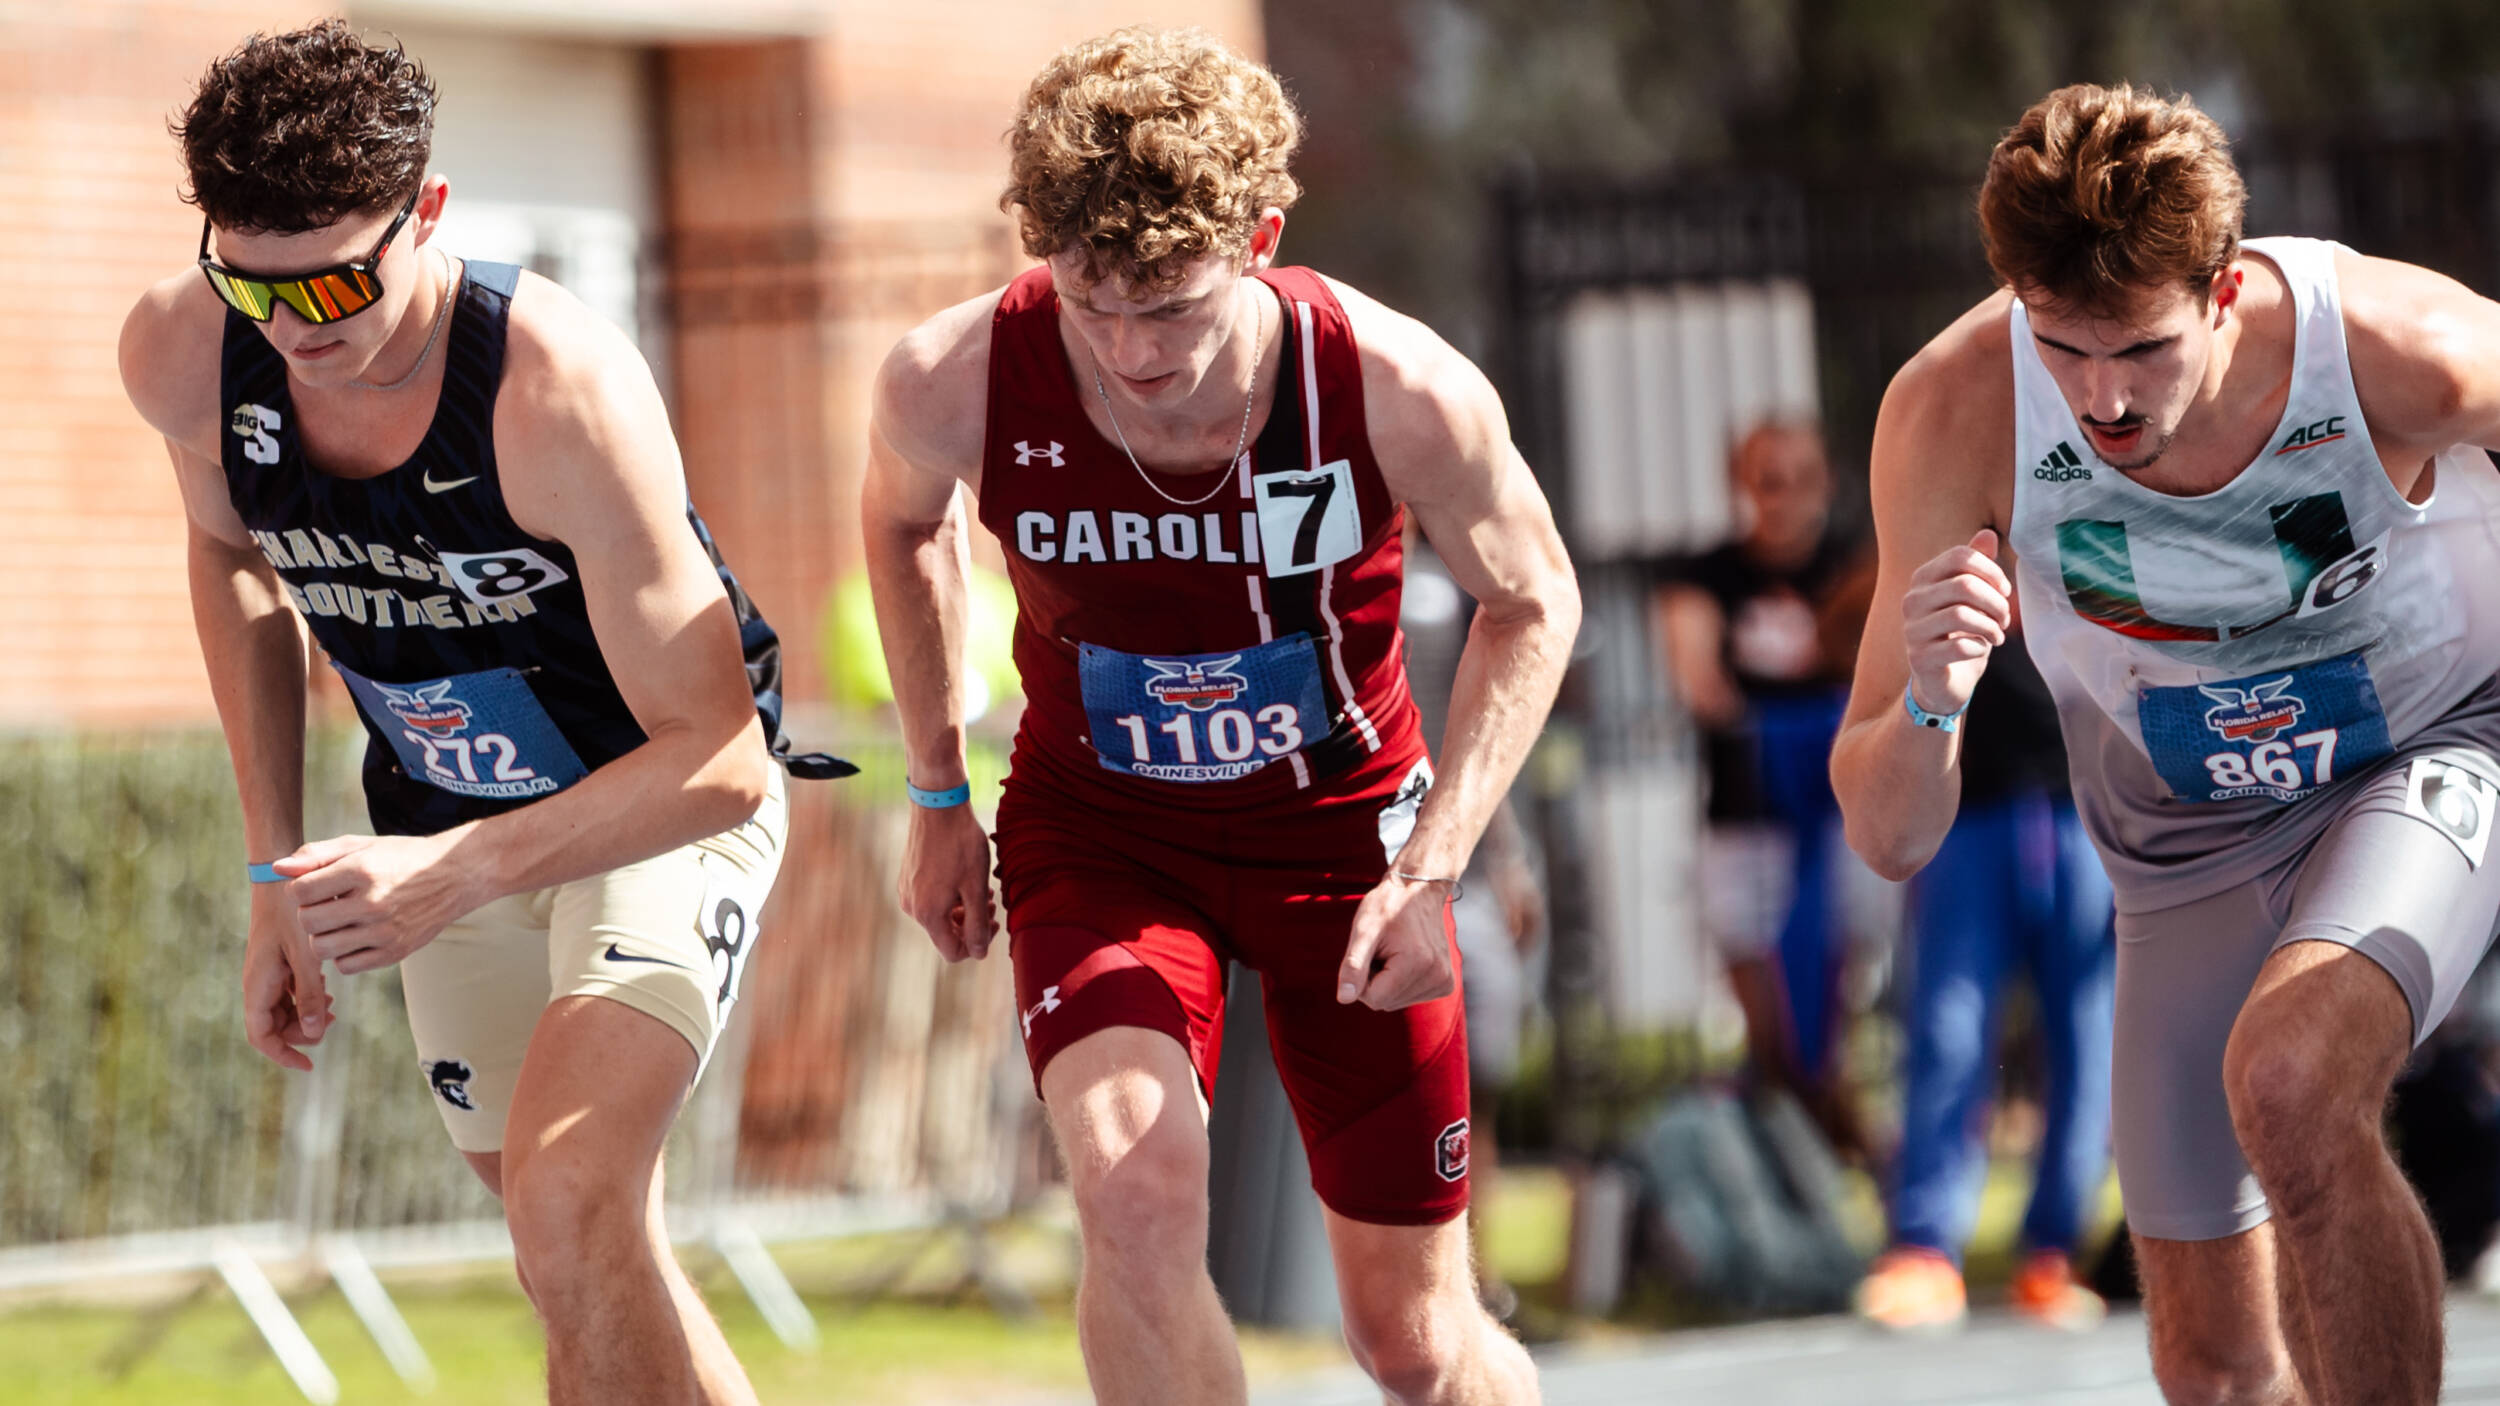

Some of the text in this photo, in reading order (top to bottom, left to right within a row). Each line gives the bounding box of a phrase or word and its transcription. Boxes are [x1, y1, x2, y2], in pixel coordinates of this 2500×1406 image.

[232, 412, 259, 430] BIG
[2280, 416, 2347, 449] ACC
[2034, 464, 2093, 483] adidas
[1016, 510, 1261, 563] CAROLI
[1267, 472, 1336, 568] 7
[461, 557, 547, 598] 8
[2312, 546, 2387, 608] 6
[1154, 681, 1240, 694] FLORIDA RELAYS
[1116, 703, 1304, 764] 1103
[2212, 715, 2259, 727] FLORIDA
[2259, 704, 2297, 721] RELAYS
[403, 729, 537, 783] 272
[2203, 727, 2338, 791] 867
